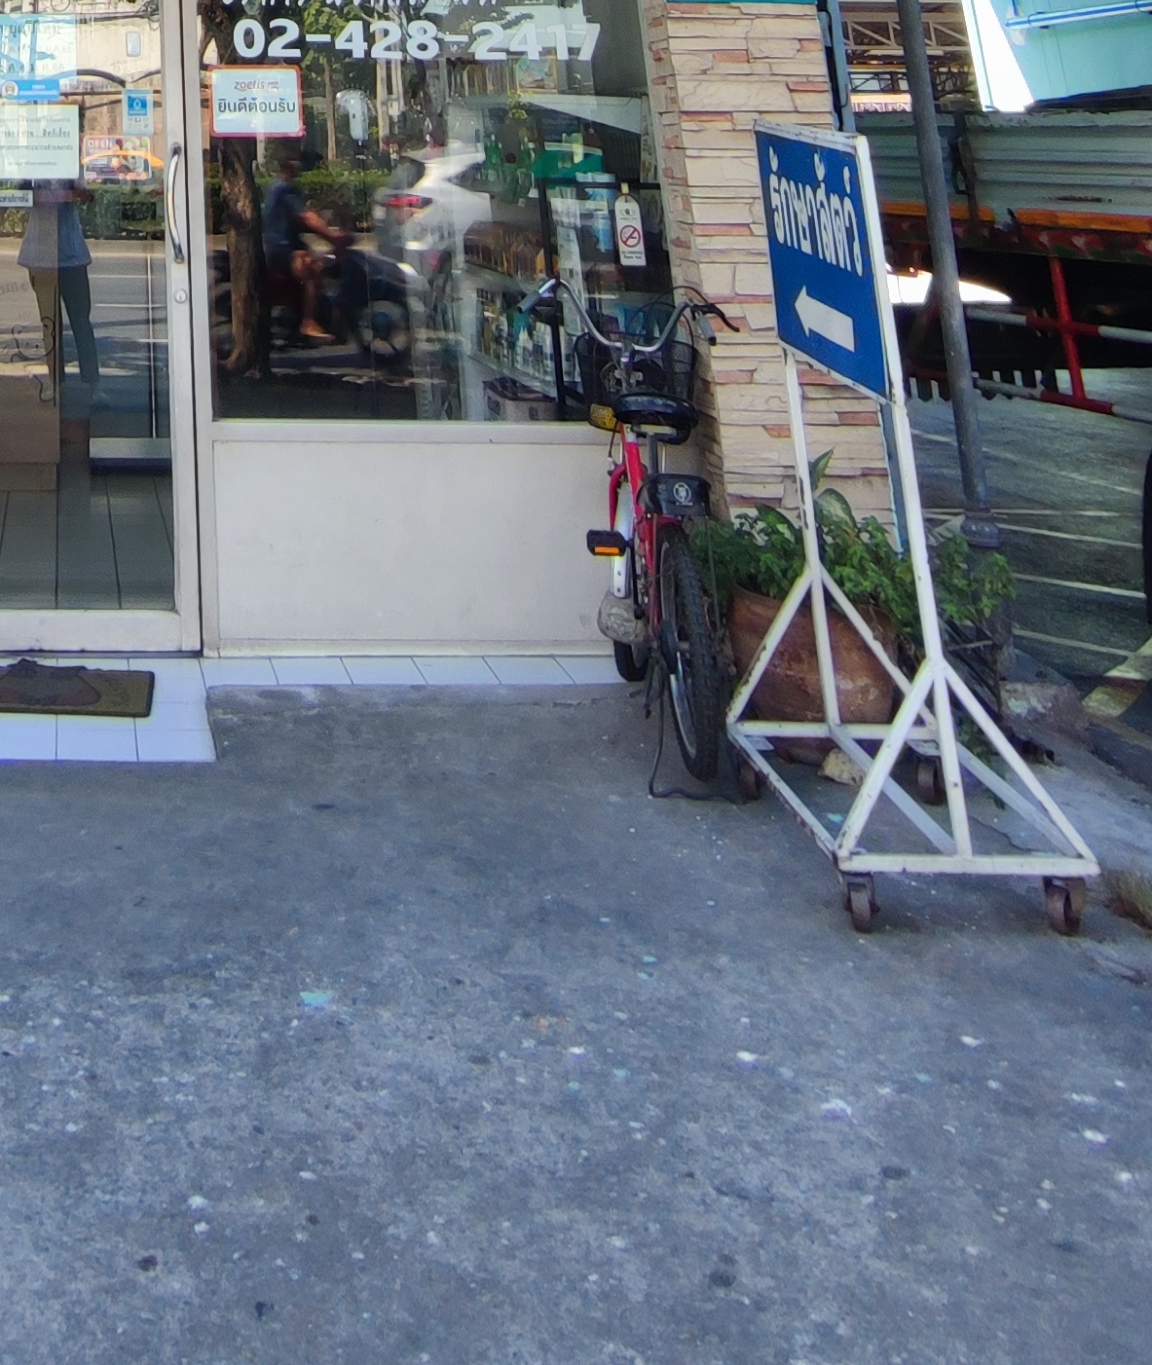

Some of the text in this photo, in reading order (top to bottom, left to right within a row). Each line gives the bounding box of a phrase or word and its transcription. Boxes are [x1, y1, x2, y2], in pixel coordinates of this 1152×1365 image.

[232, 17, 601, 62] 02-428-2417
[234, 79, 265, 92] zoetis
[217, 96, 296, 113] ยินดีต้อนรับ
[769, 144, 864, 278] รักษาสัตว์
